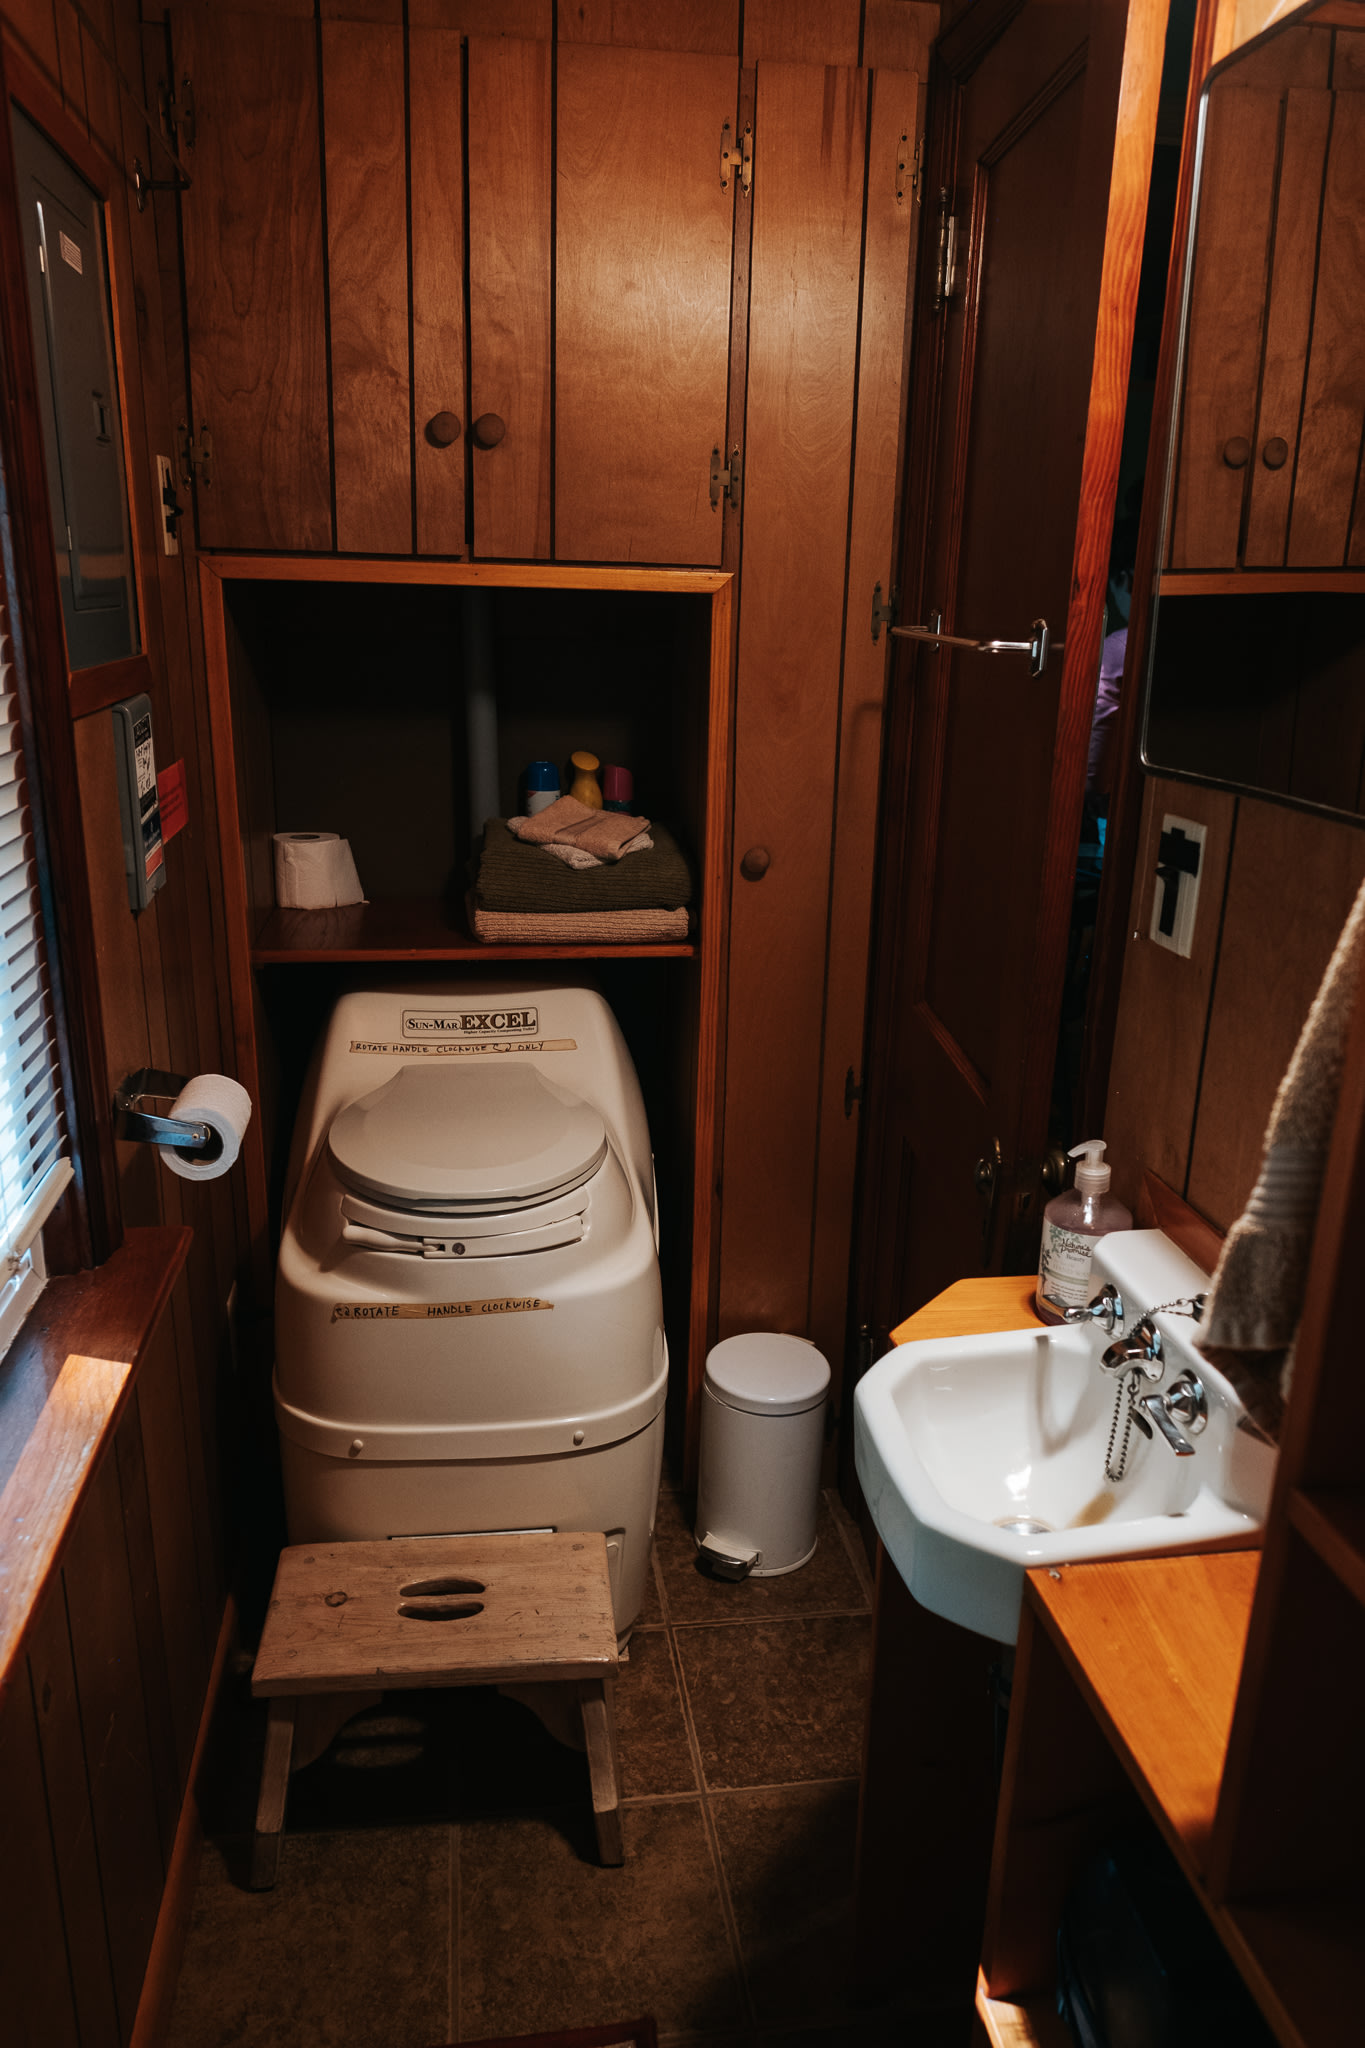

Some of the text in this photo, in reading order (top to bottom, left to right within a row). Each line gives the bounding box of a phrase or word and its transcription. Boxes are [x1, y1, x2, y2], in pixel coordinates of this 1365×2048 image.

[460, 1012, 536, 1030] EXCEL
[355, 1041, 544, 1053] ROTATE HANDLE CLOCKWISE ONLY
[353, 1299, 541, 1318] ROTATE HANDLE CLOCKWISE
